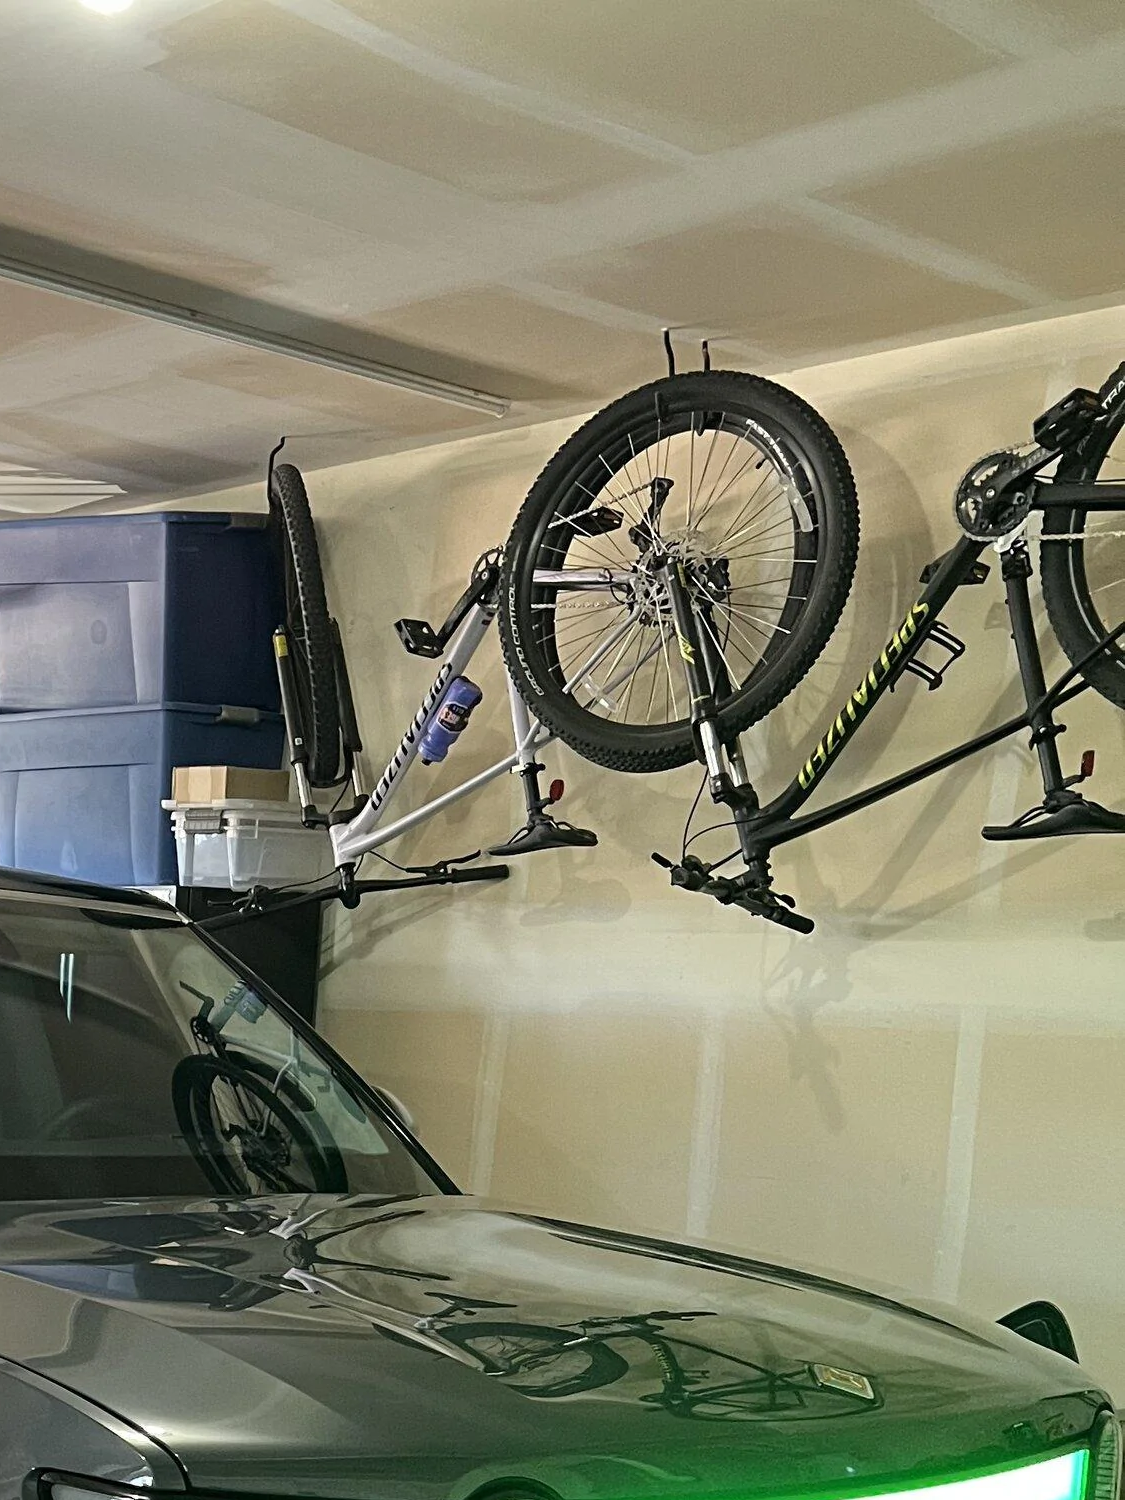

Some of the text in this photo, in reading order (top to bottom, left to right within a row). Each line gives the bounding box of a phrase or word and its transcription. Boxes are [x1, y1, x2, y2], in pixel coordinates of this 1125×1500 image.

[1101, 374, 1125, 410] TRA
[508, 586, 545, 696] GROUND CONTROL
[798, 602, 929, 790] SPECIALIZED
[370, 662, 453, 811] SPECIALIZED
